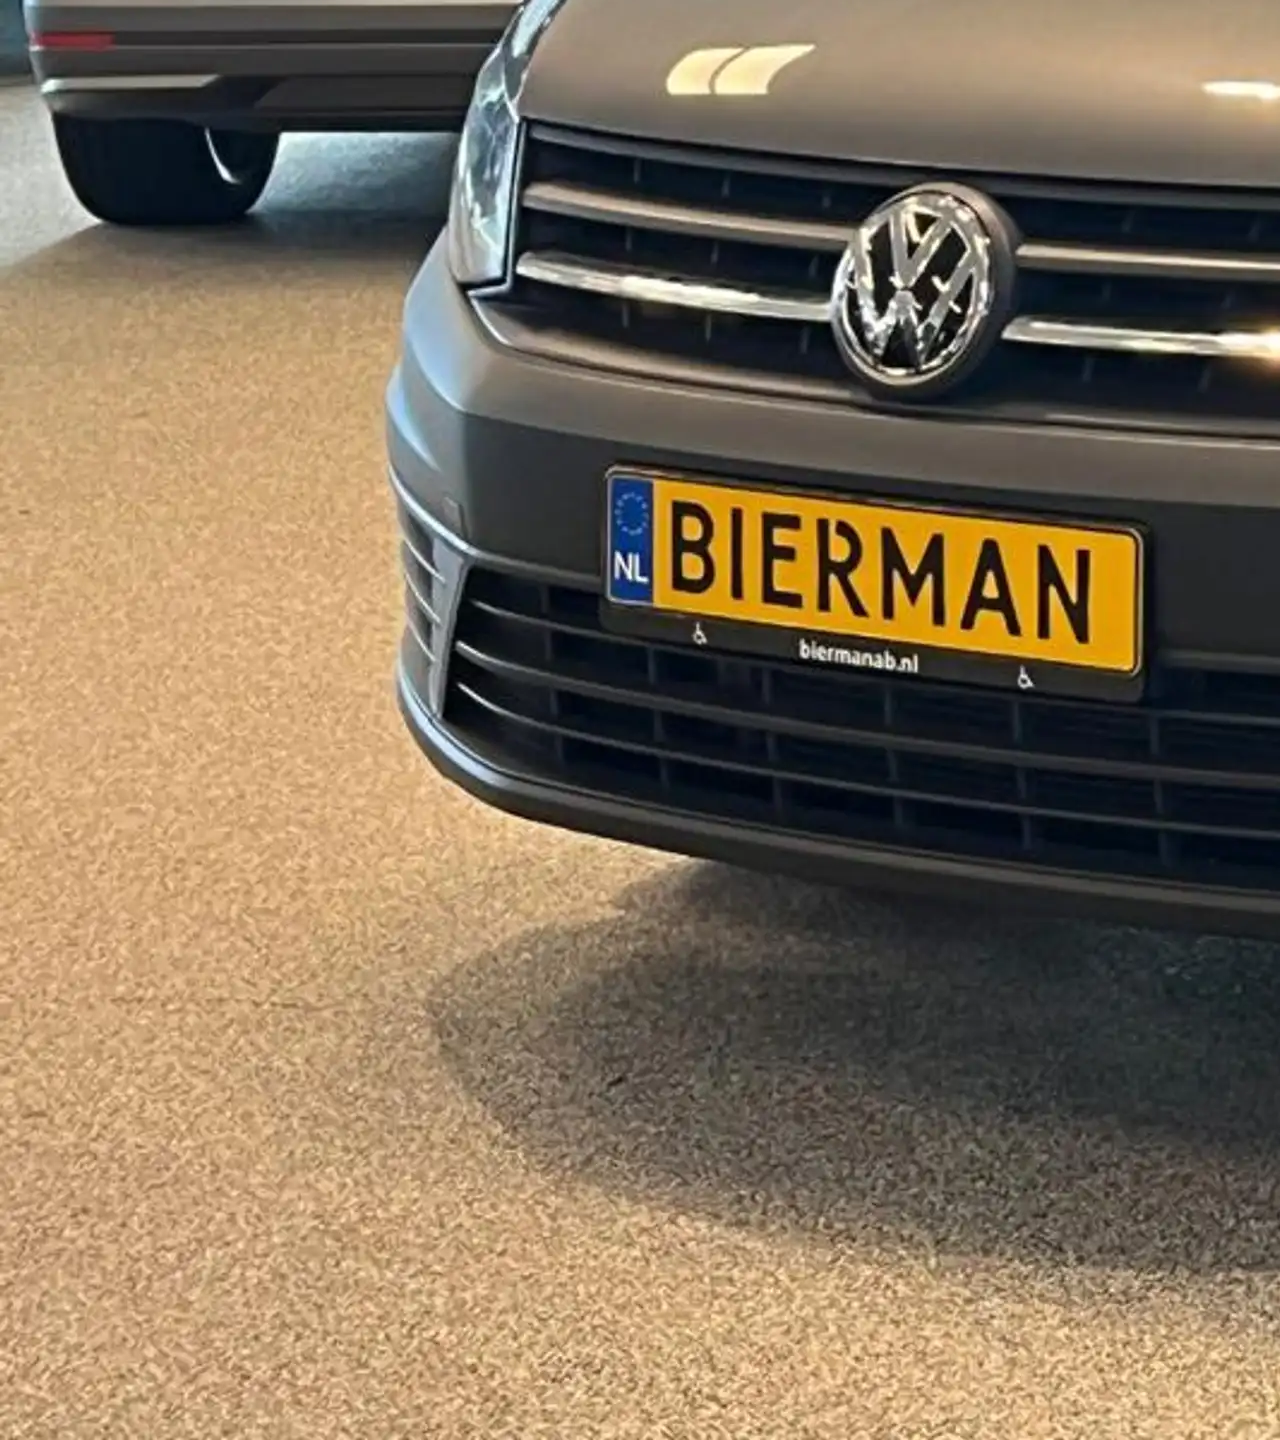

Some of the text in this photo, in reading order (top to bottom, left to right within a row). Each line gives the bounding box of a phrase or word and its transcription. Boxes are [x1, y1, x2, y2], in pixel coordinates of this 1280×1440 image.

[613, 499, 1091, 644] NL BIERMAN
[799, 638, 918, 673] biermanab.nl
